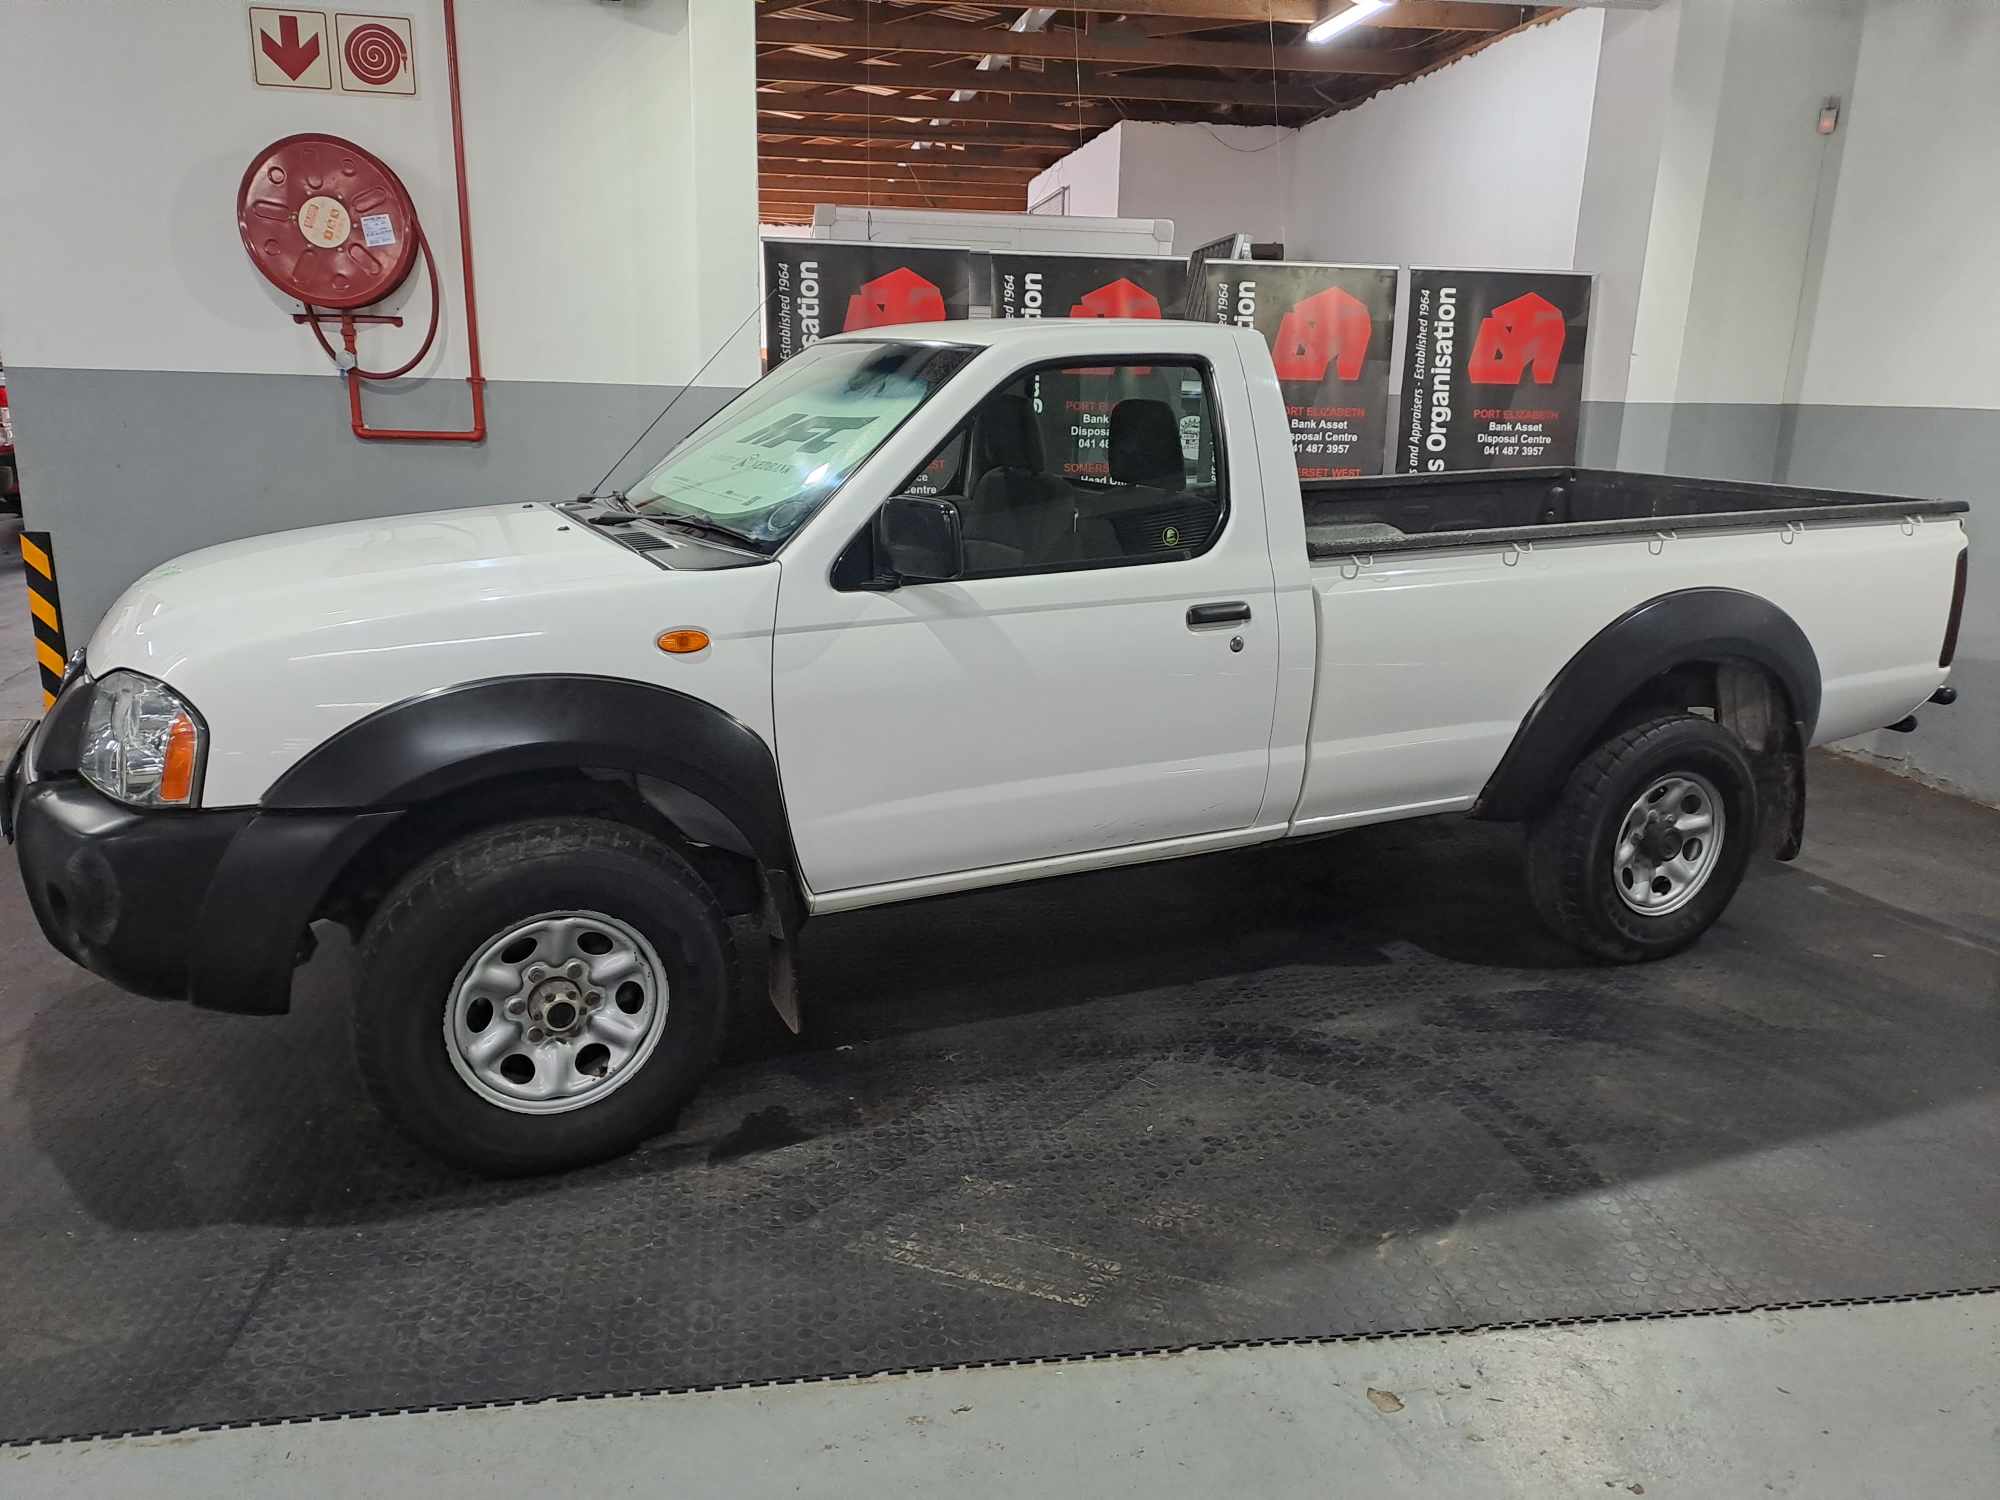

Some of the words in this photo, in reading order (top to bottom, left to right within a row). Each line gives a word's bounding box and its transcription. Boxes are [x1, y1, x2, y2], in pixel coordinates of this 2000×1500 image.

[778, 262, 791, 292] 1964
[1003, 274, 1015, 303] 1964
[1217, 283, 1229, 310] 1964
[797, 261, 820, 349] sation
[1419, 289, 1430, 316] 1964
[778, 294, 791, 360] Established
[1413, 318, 1428, 380] Established
[1425, 287, 1457, 452] Organisation
[1083, 414, 1109, 424] Bank
[1409, 388, 1424, 444] Appraisers
[1473, 409, 1501, 419] PORT
[1503, 410, 1560, 421] ELIZABETH
[1291, 419, 1316, 429] Bank
[1319, 420, 1348, 430] Asset
[1489, 421, 1513, 431] Bank
[1514, 422, 1543, 432] Asset
[1078, 439, 1095, 449] 041
[1288, 432, 1322, 443] sposal
[1325, 432, 1358, 442] Centre
[1477, 434, 1518, 445] Disposal
[1520, 434, 1552, 444] Centre
[1306, 444, 1324, 453] 487
[1326, 444, 1350, 454] 3957
[1407, 445, 1420, 467] and
[1484, 446, 1499, 455] 041
[1502, 446, 1519, 456] 487
[1522, 446, 1545, 456] 3957
[1299, 467, 1328, 477] ERSET
